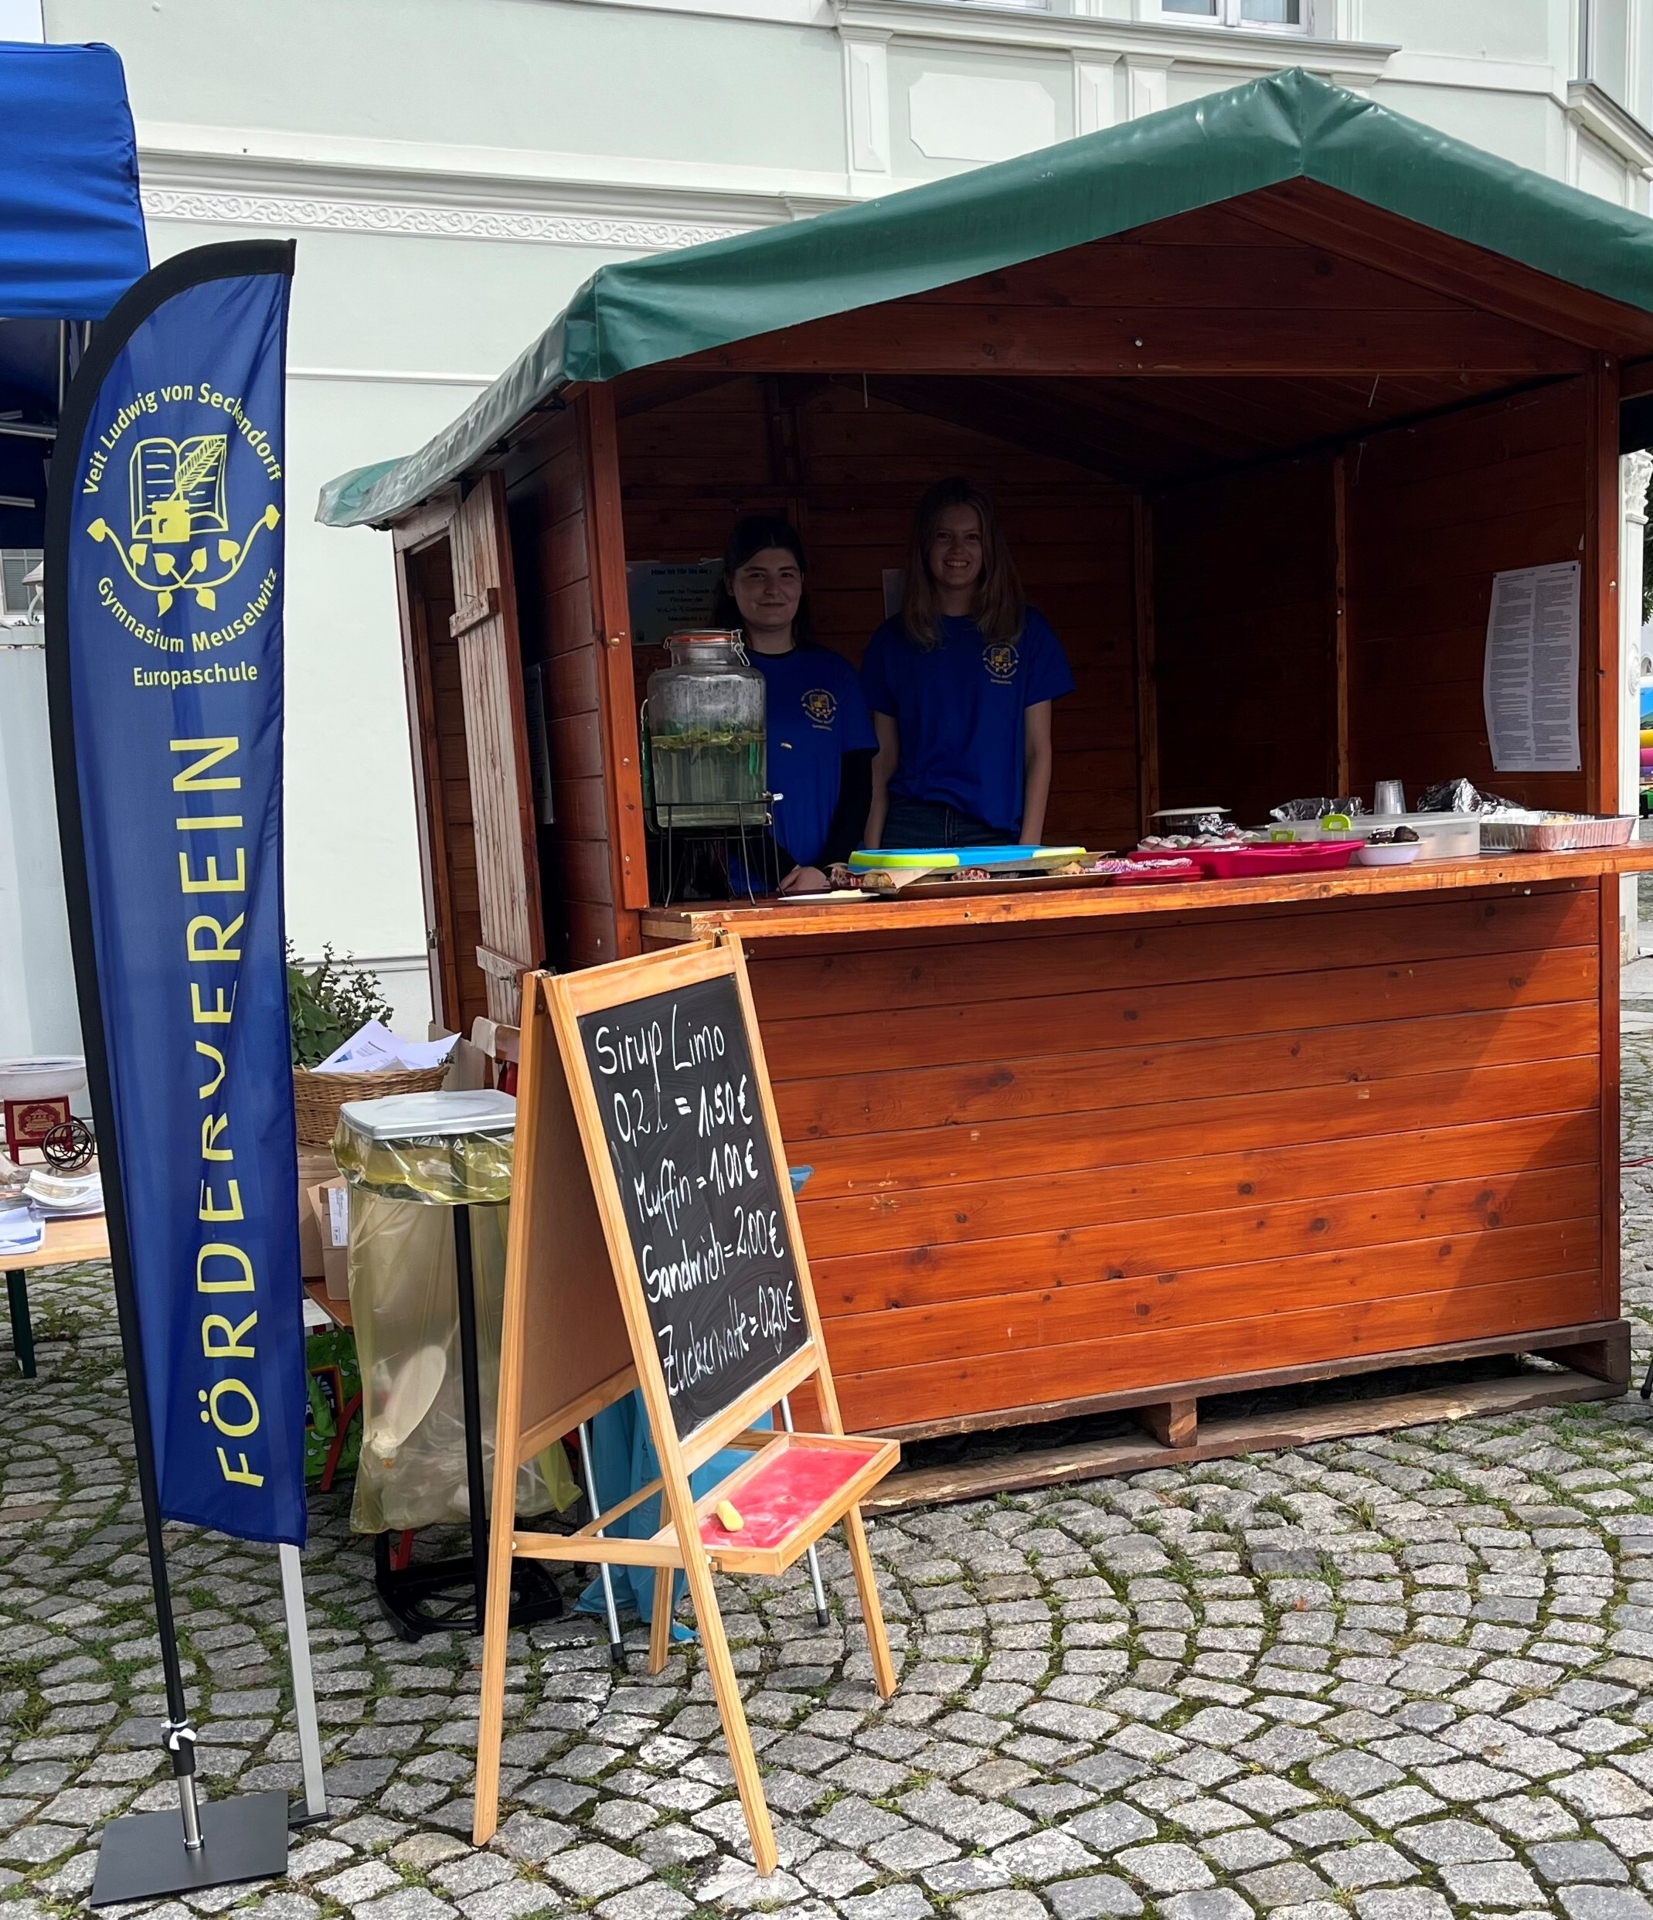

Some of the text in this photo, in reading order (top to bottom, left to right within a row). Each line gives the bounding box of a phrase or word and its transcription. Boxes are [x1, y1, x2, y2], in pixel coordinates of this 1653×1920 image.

[83, 451, 108, 493] Veit
[100, 391, 158, 449] Ludwig
[161, 384, 193, 402] von
[98, 568, 277, 653] Gymnasium Meuselwitz
[133, 661, 258, 690] Europaschule
[595, 1003, 725, 1093] Sirup Limo
[169, 736, 265, 1488] FÖRDERVEREIN
[698, 1073, 754, 1138] 1,50€
[633, 1158, 692, 1237] Muffin
[709, 1138, 759, 1197] 1,00€
